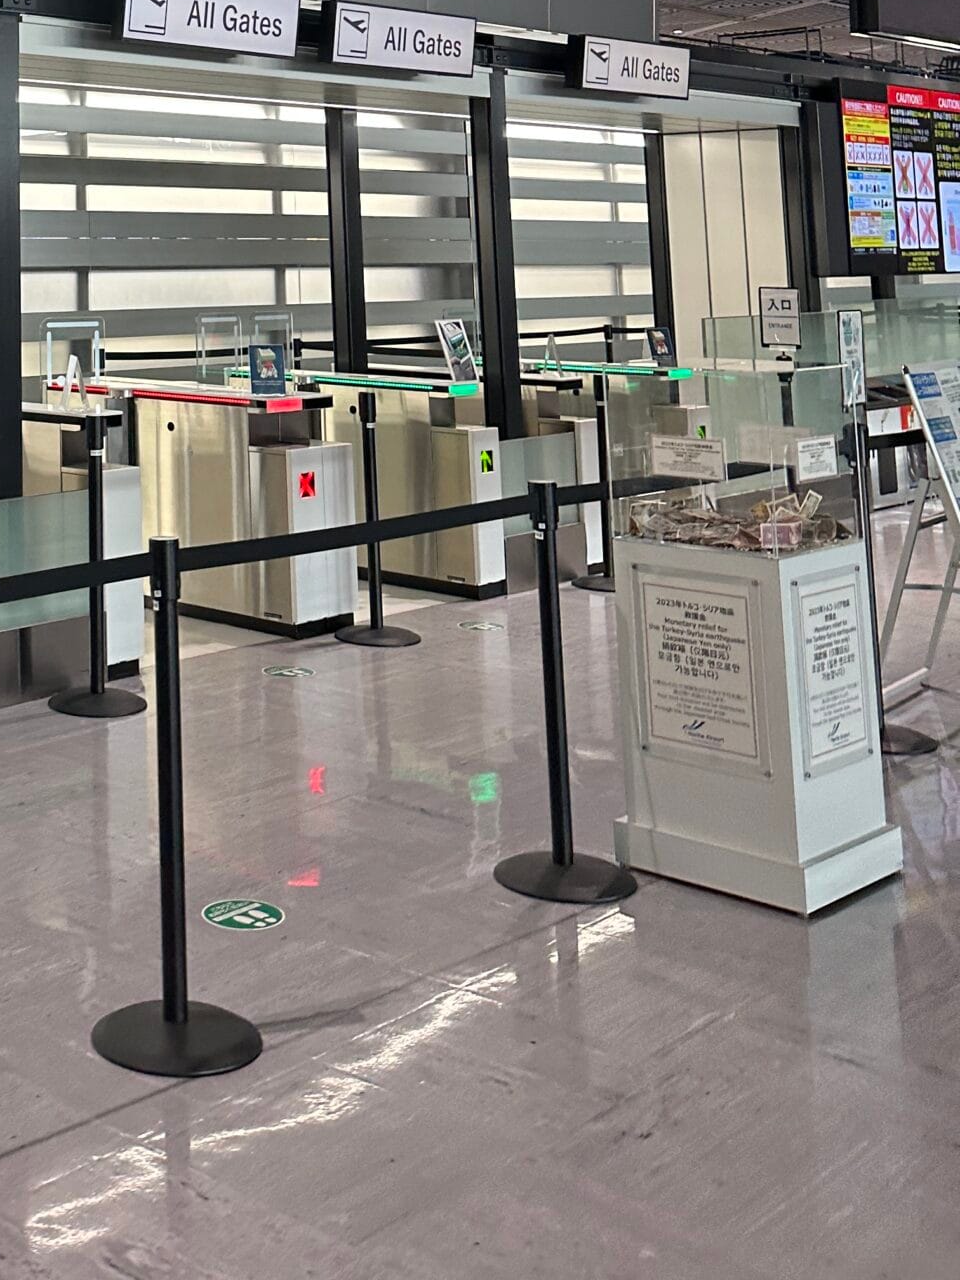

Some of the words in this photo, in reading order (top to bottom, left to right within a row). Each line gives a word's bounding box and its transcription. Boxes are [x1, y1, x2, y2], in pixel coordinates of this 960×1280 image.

[188, 0, 216, 30] All
[223, 4, 283, 38] Gates
[384, 26, 407, 53] All
[413, 29, 462, 59] Gates
[621, 56, 639, 79] All
[643, 59, 680, 84] Gates
[768, 298, 792, 311] 入口
